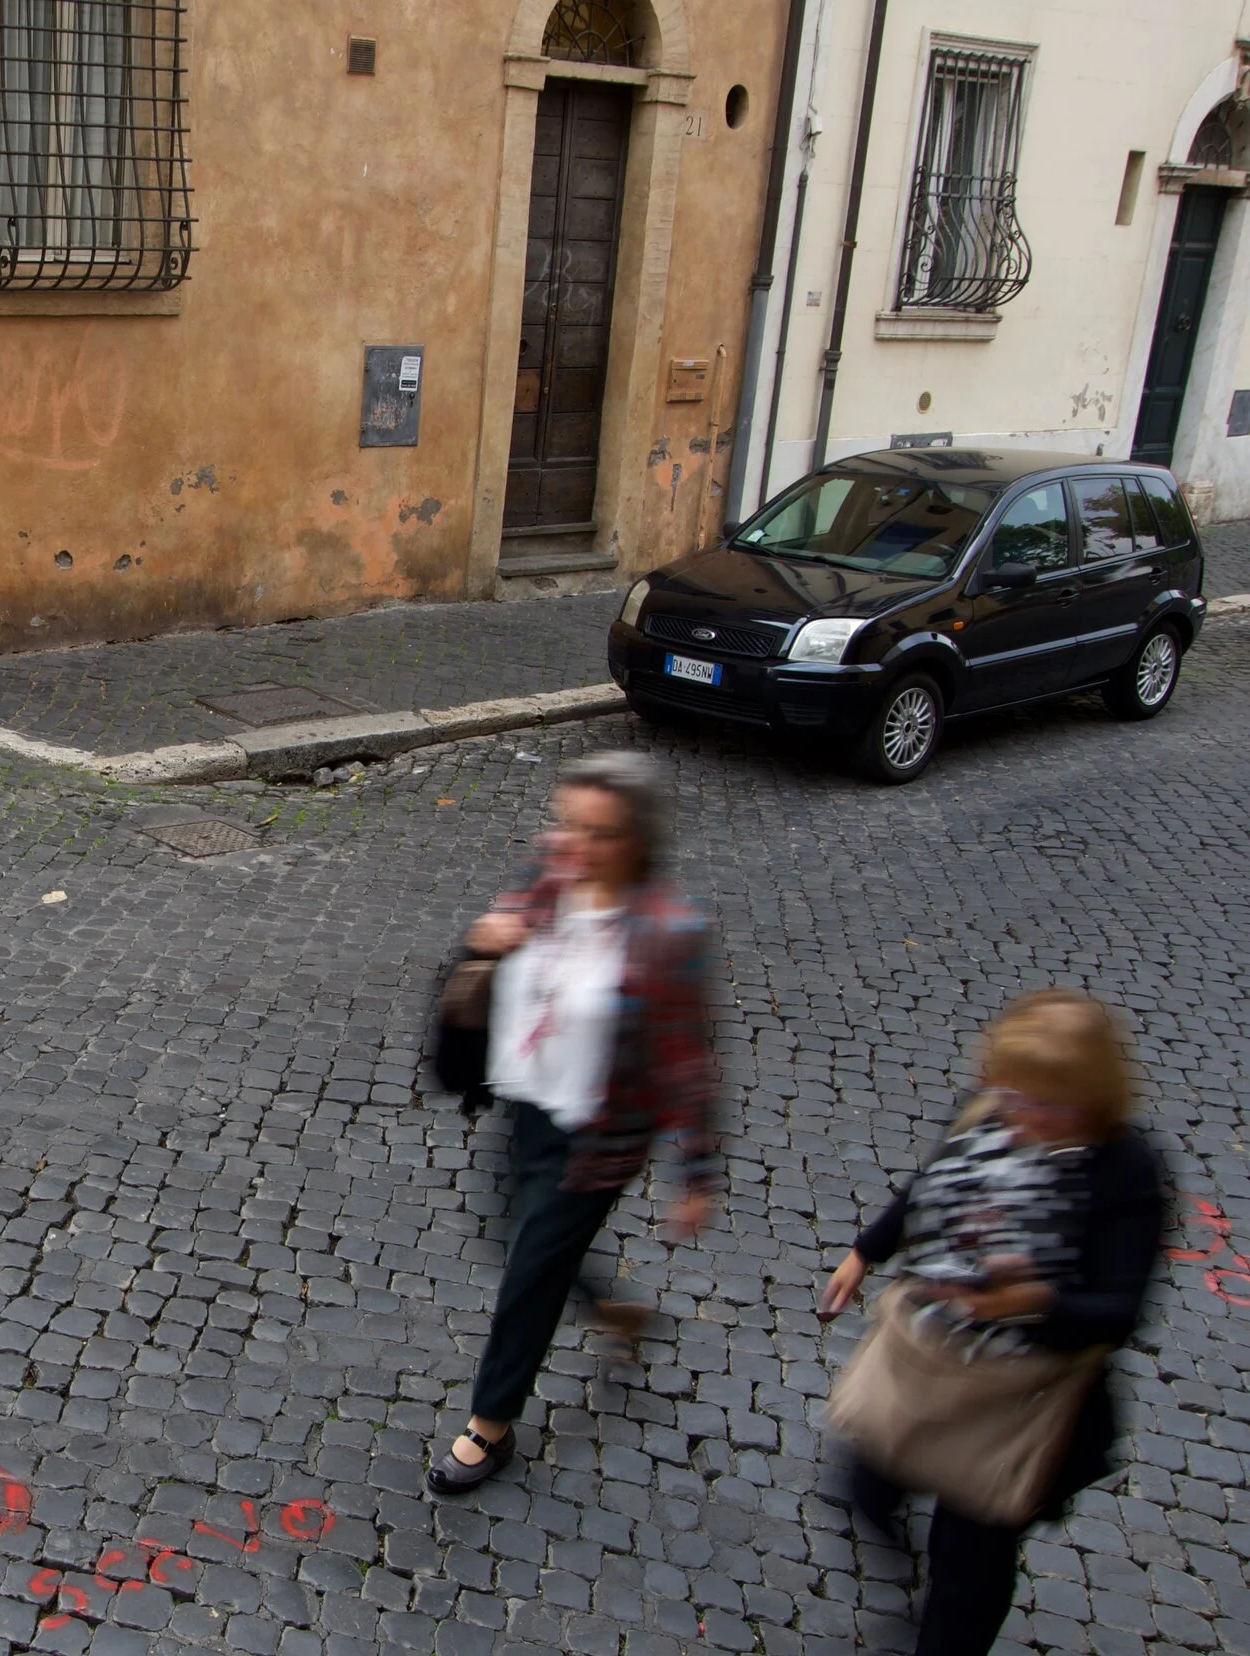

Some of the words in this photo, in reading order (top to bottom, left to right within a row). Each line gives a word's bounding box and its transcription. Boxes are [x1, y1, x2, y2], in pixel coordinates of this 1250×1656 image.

[686, 115, 702, 136] 21
[672, 659, 683, 673] DA
[685, 662, 714, 680] 495NW
